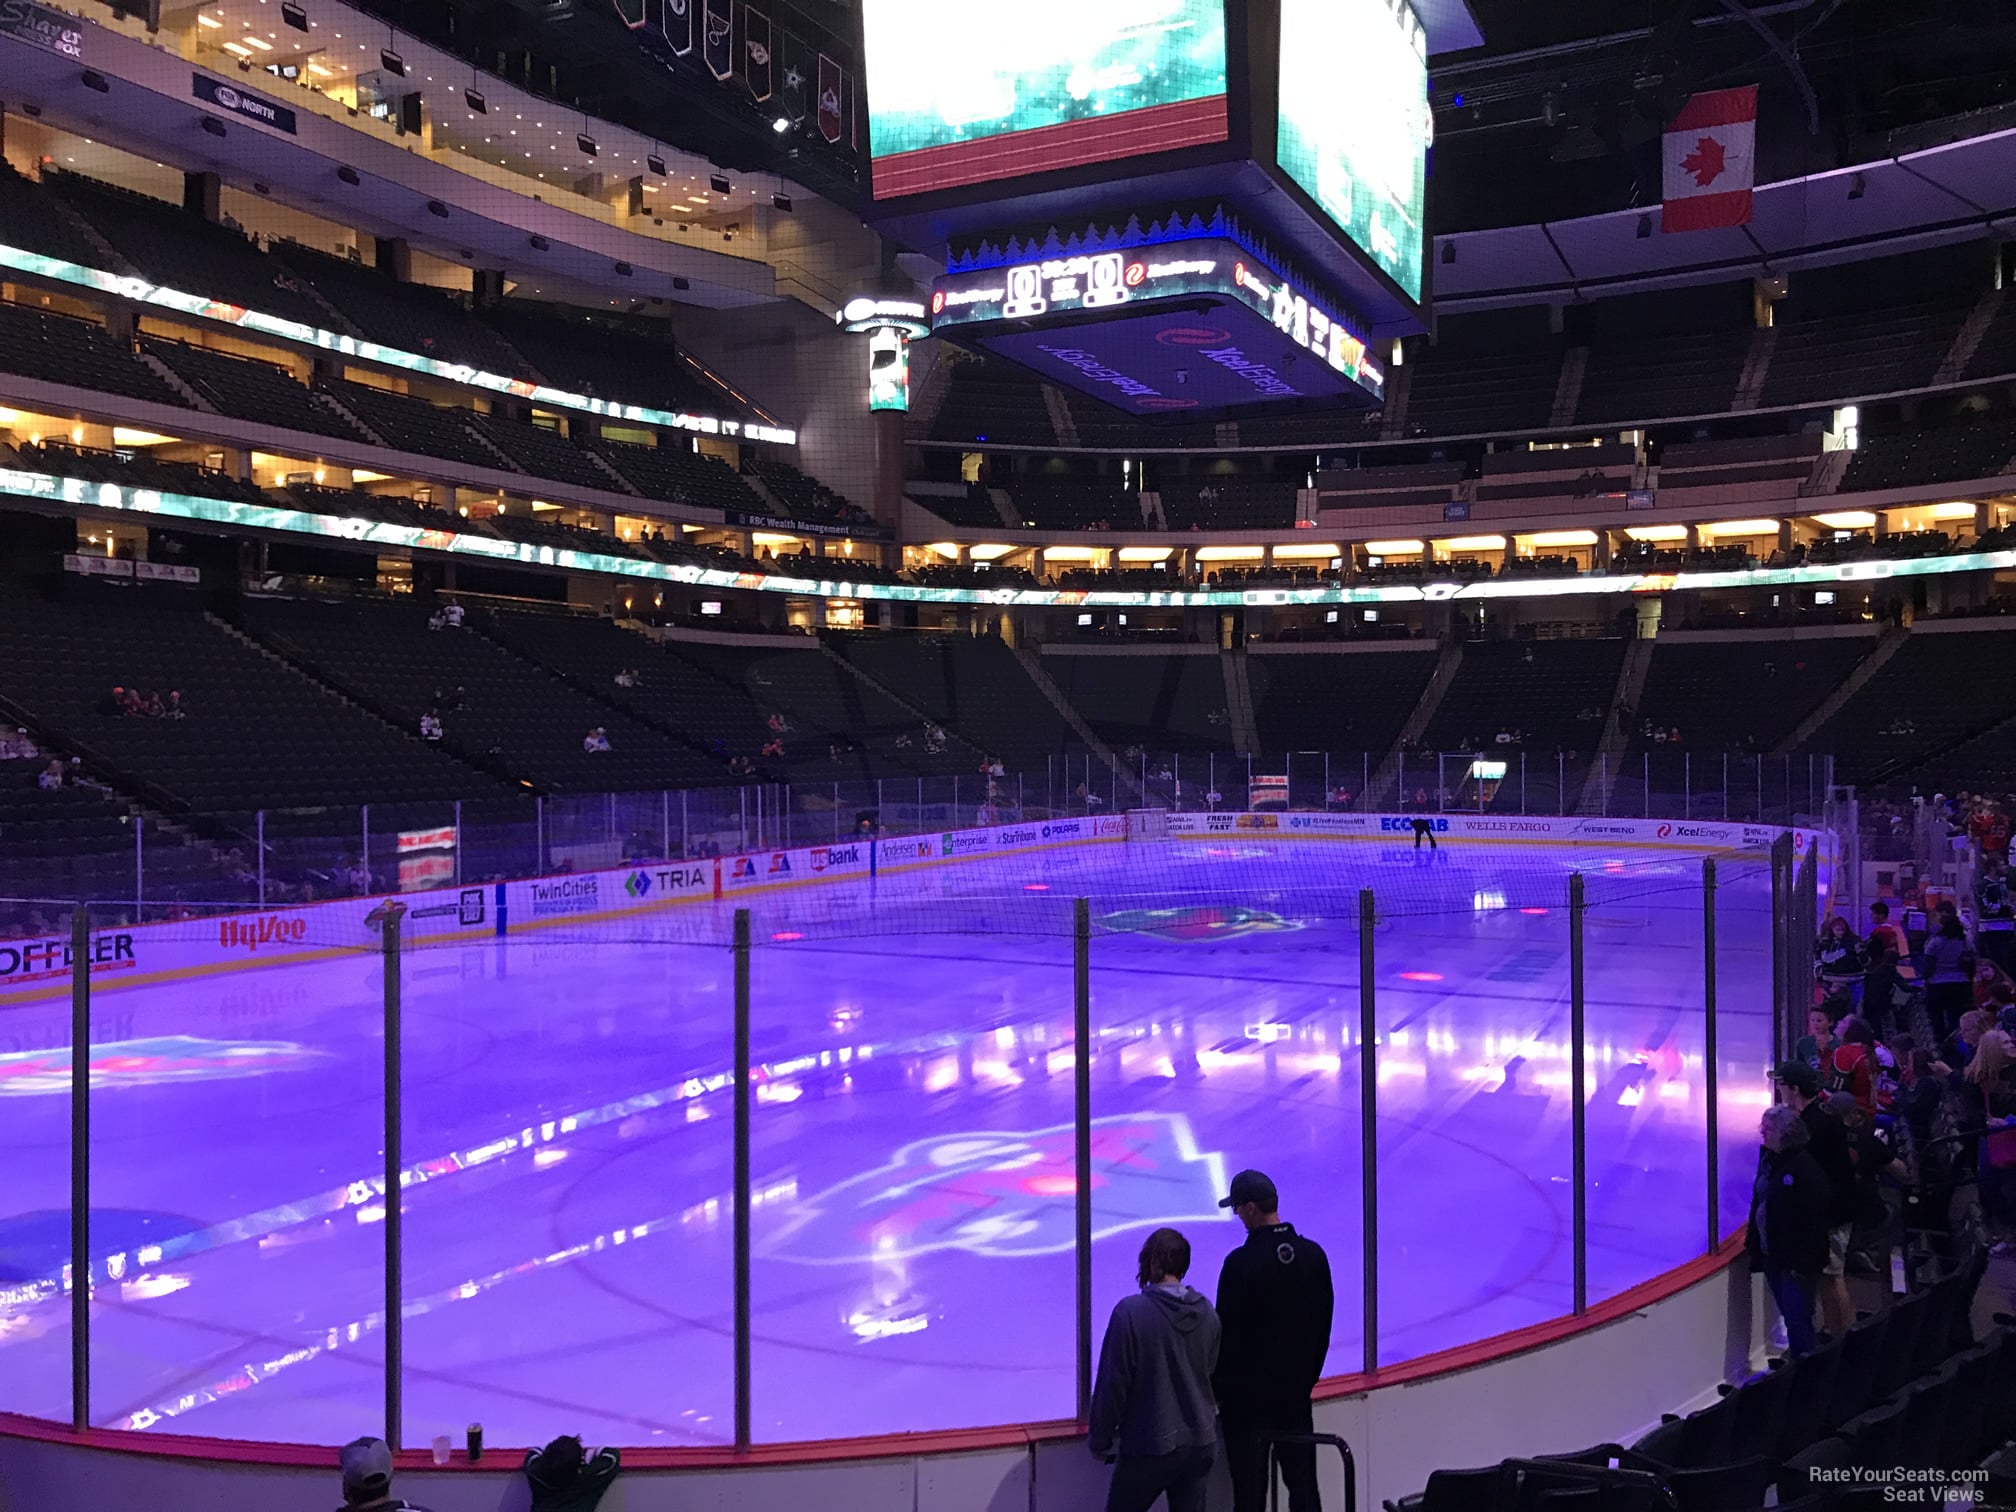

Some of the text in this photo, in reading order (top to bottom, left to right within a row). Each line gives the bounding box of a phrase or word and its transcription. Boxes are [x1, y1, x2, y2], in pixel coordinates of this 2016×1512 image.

[242, 98, 275, 120] NORTH
[749, 515, 849, 535] RBC Wealth Management
[1052, 823, 1080, 834] POLARIS
[1380, 816, 1449, 832] ECOAB
[1465, 821, 1551, 832] WELLS FARGO
[656, 868, 705, 891] TRIA
